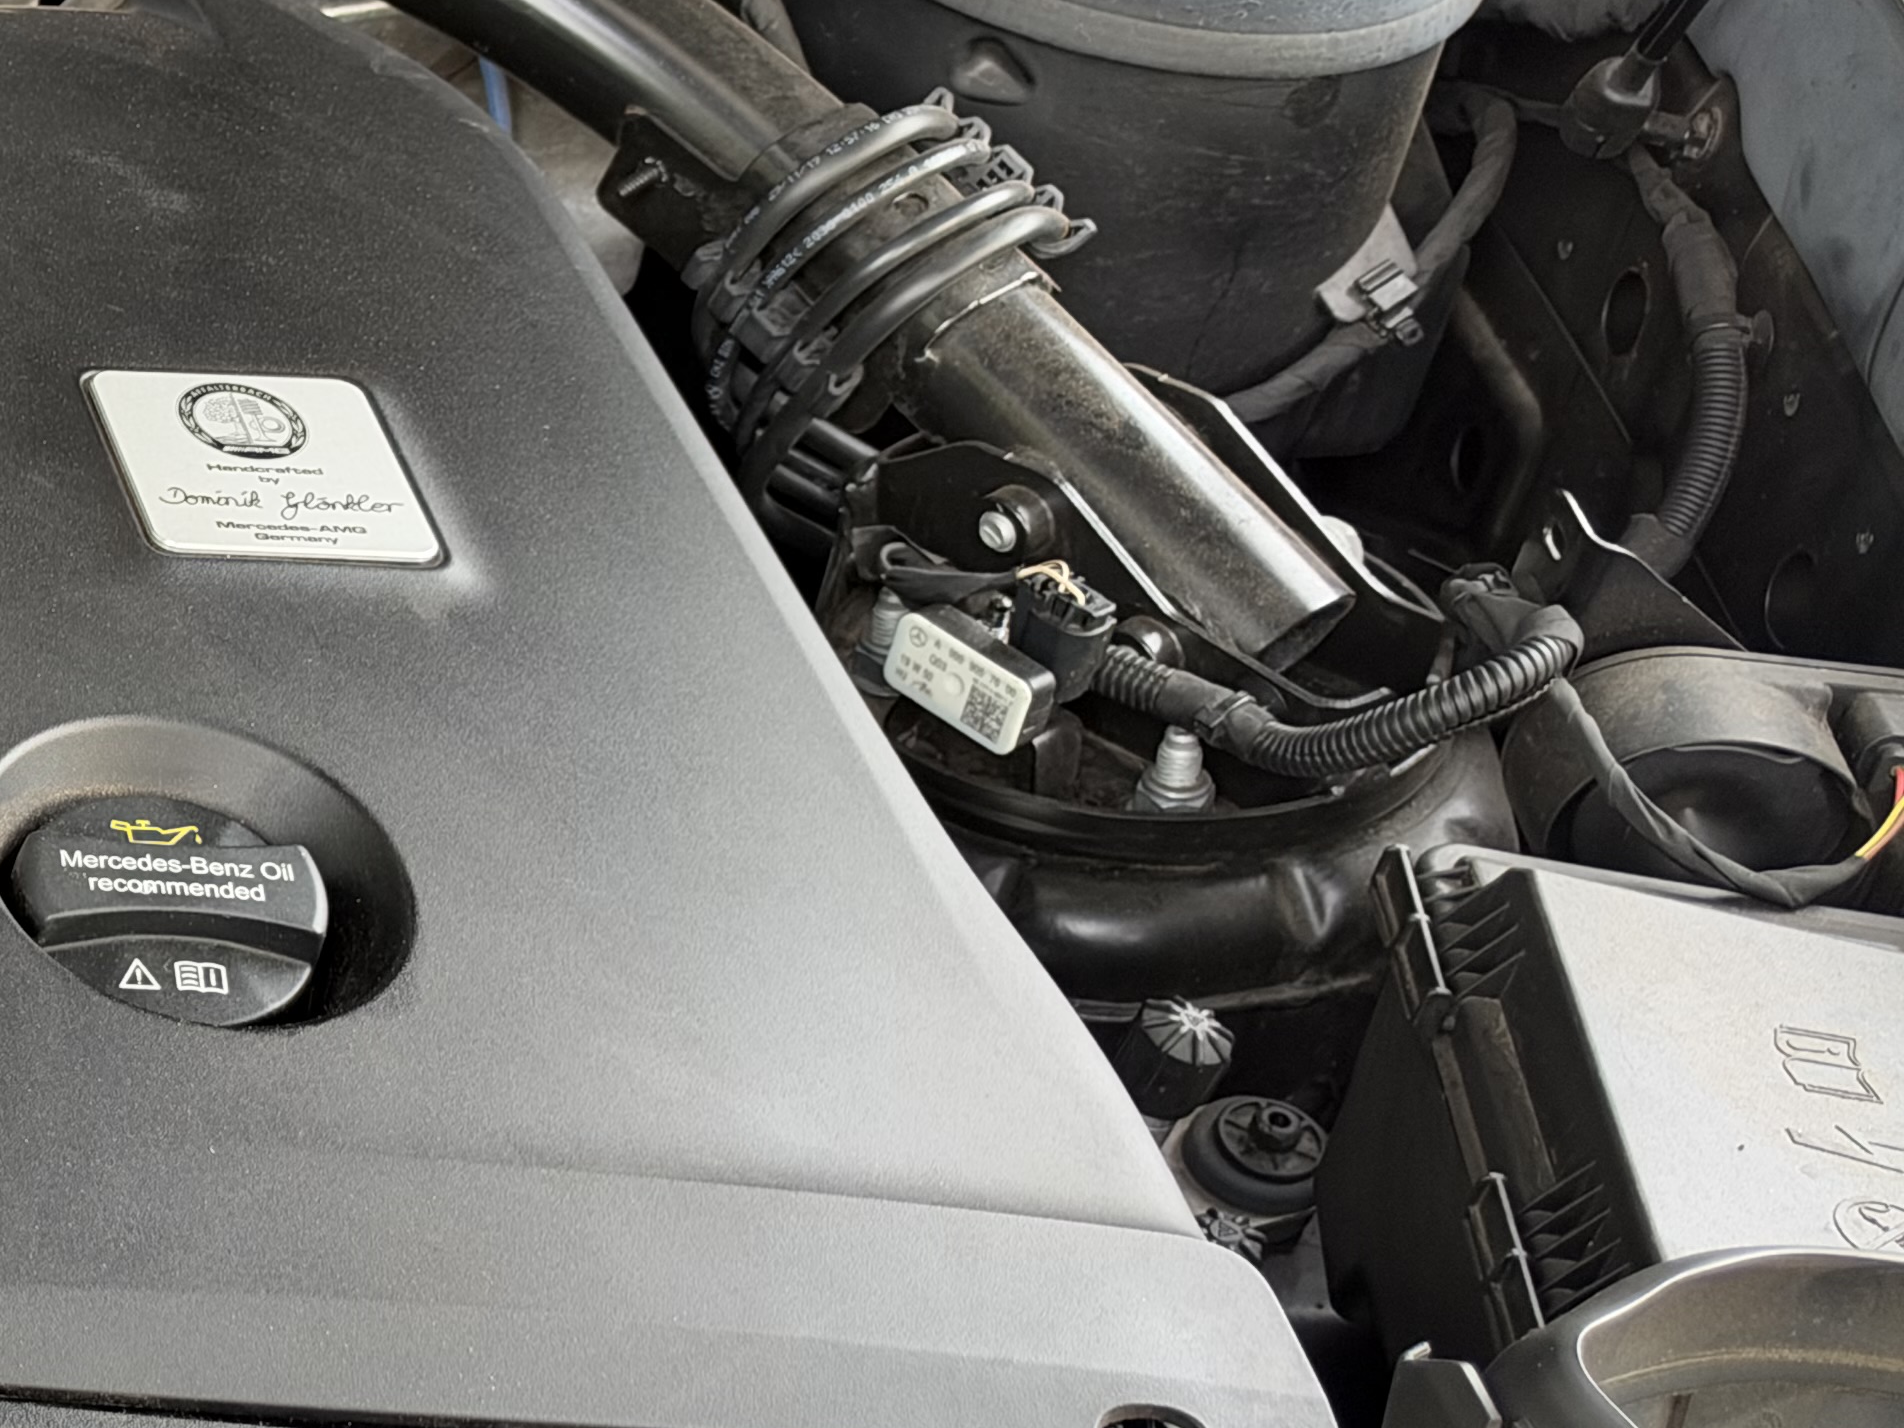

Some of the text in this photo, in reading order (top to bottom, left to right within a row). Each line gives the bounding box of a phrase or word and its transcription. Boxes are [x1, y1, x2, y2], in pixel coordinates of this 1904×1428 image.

[206, 462, 325, 476] Handcrafted
[258, 475, 281, 486] by
[158, 486, 264, 509] Dominik
[215, 520, 368, 535] Mercedes-AMG
[254, 532, 339, 546] Germany
[58, 848, 296, 883] Mercedes-Benz Oil
[87, 874, 267, 903] recommended
